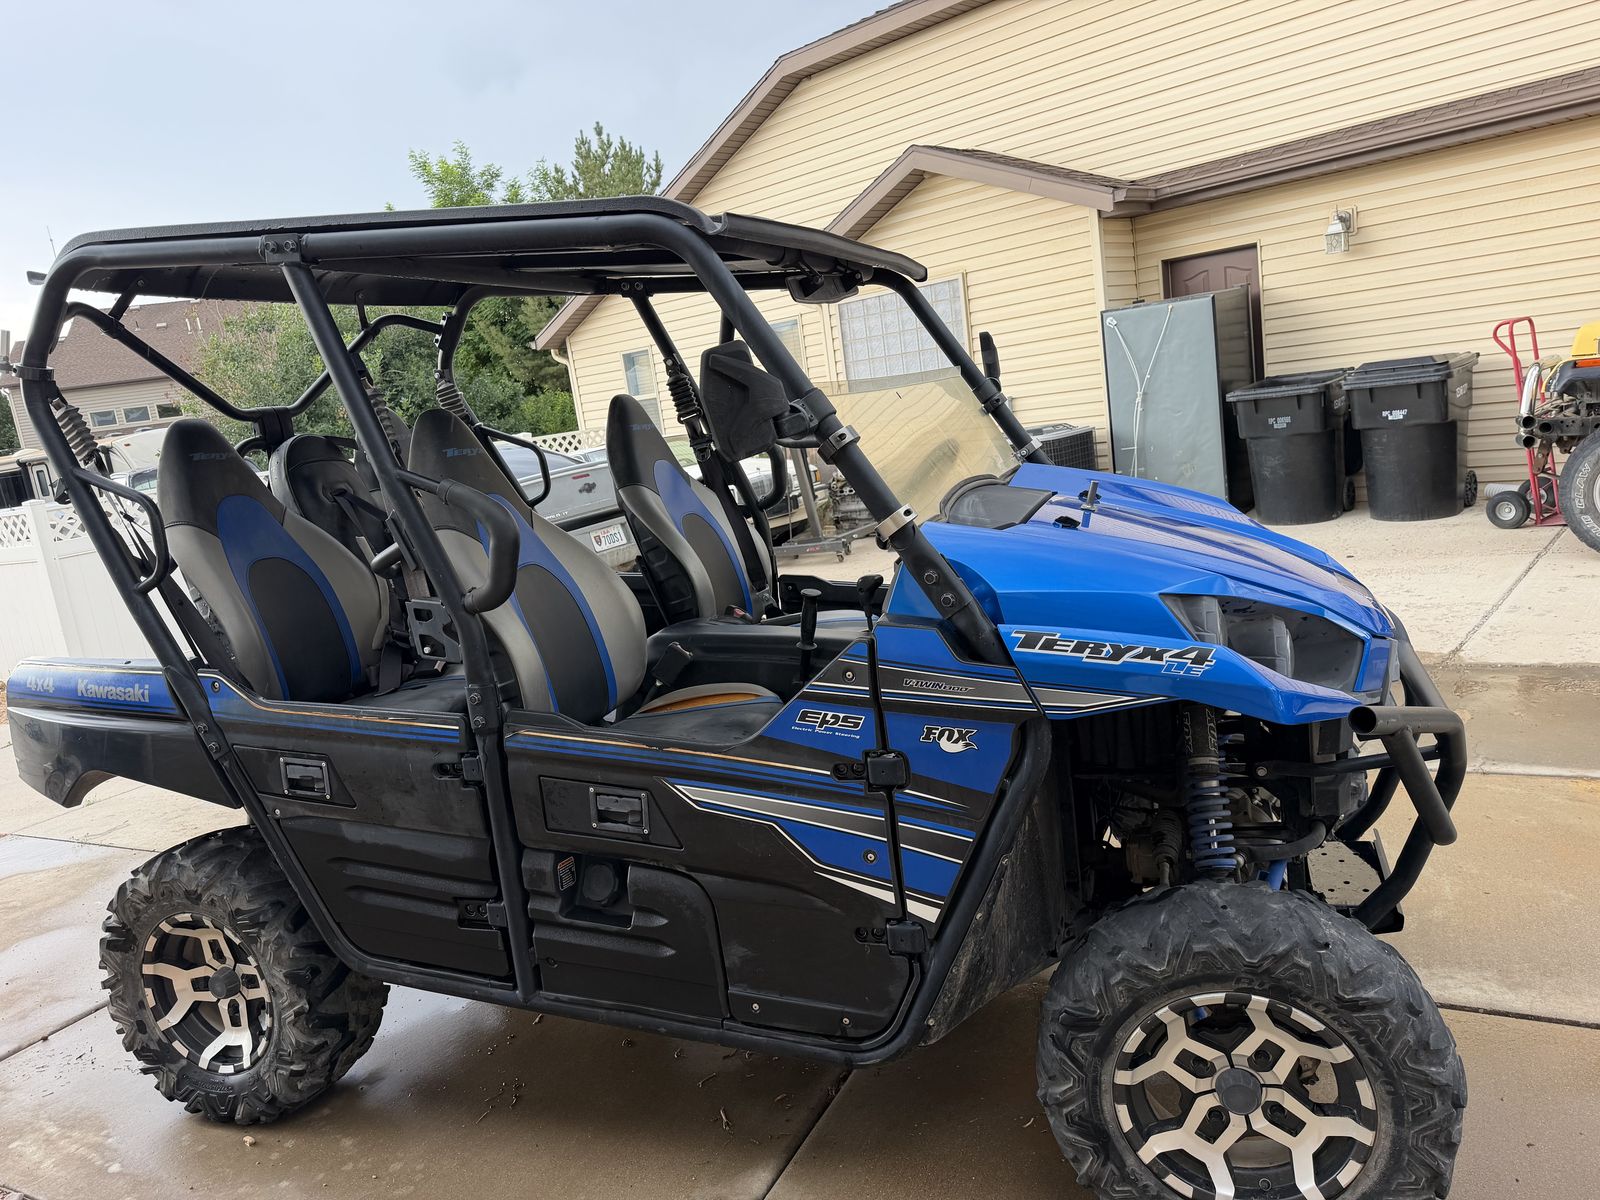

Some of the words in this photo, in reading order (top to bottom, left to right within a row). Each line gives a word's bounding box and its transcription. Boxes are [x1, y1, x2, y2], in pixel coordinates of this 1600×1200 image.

[1574, 462, 1591, 509] CLAW
[1162, 660, 1213, 677] LE
[77, 679, 150, 703] Kawasaki
[791, 725, 813, 733] Electric
[835, 731, 861, 740] Steering
[920, 725, 978, 745] FOX
